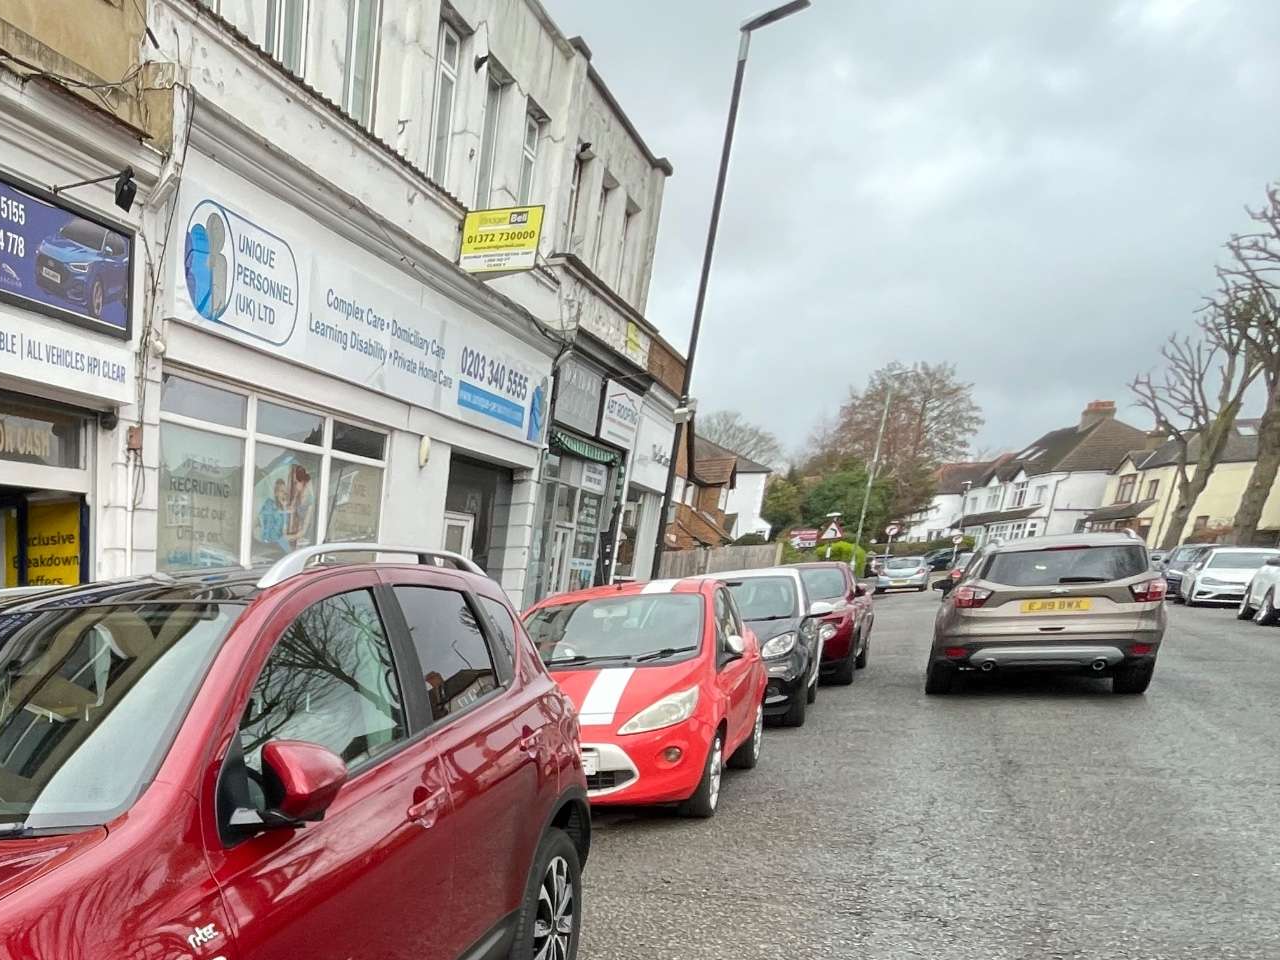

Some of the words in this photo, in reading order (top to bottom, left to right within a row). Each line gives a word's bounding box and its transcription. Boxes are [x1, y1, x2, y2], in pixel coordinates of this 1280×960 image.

[1, 196, 25, 225] 5155
[7, 232, 25, 258] 778
[238, 233, 276, 269] UNIQUE
[467, 233, 495, 244] 01372
[499, 230, 536, 241] 730000
[236, 263, 294, 306] PERSONNEL
[235, 293, 256, 322] (UK)
[258, 303, 276, 325] LTD
[326, 288, 365, 322] Complex
[366, 308, 385, 331] Care
[391, 319, 430, 356] Domiciliary
[430, 339, 446, 360] Care
[26, 344, 44, 364] ALL
[45, 347, 85, 373] VEHICLES
[85, 357, 101, 376] HPI
[102, 360, 126, 385] CLEAR
[309, 312, 348, 351] Learning
[350, 331, 387, 366] Disability
[392, 350, 417, 374] Private
[418, 361, 438, 382] Home
[438, 370, 453, 389] Care
[461, 346, 486, 382] 0203
[488, 360, 505, 390] 340
[507, 368, 529, 401] 5555
[169, 477, 231, 498] RECRUITING
[26, 531, 75, 547] clusive
